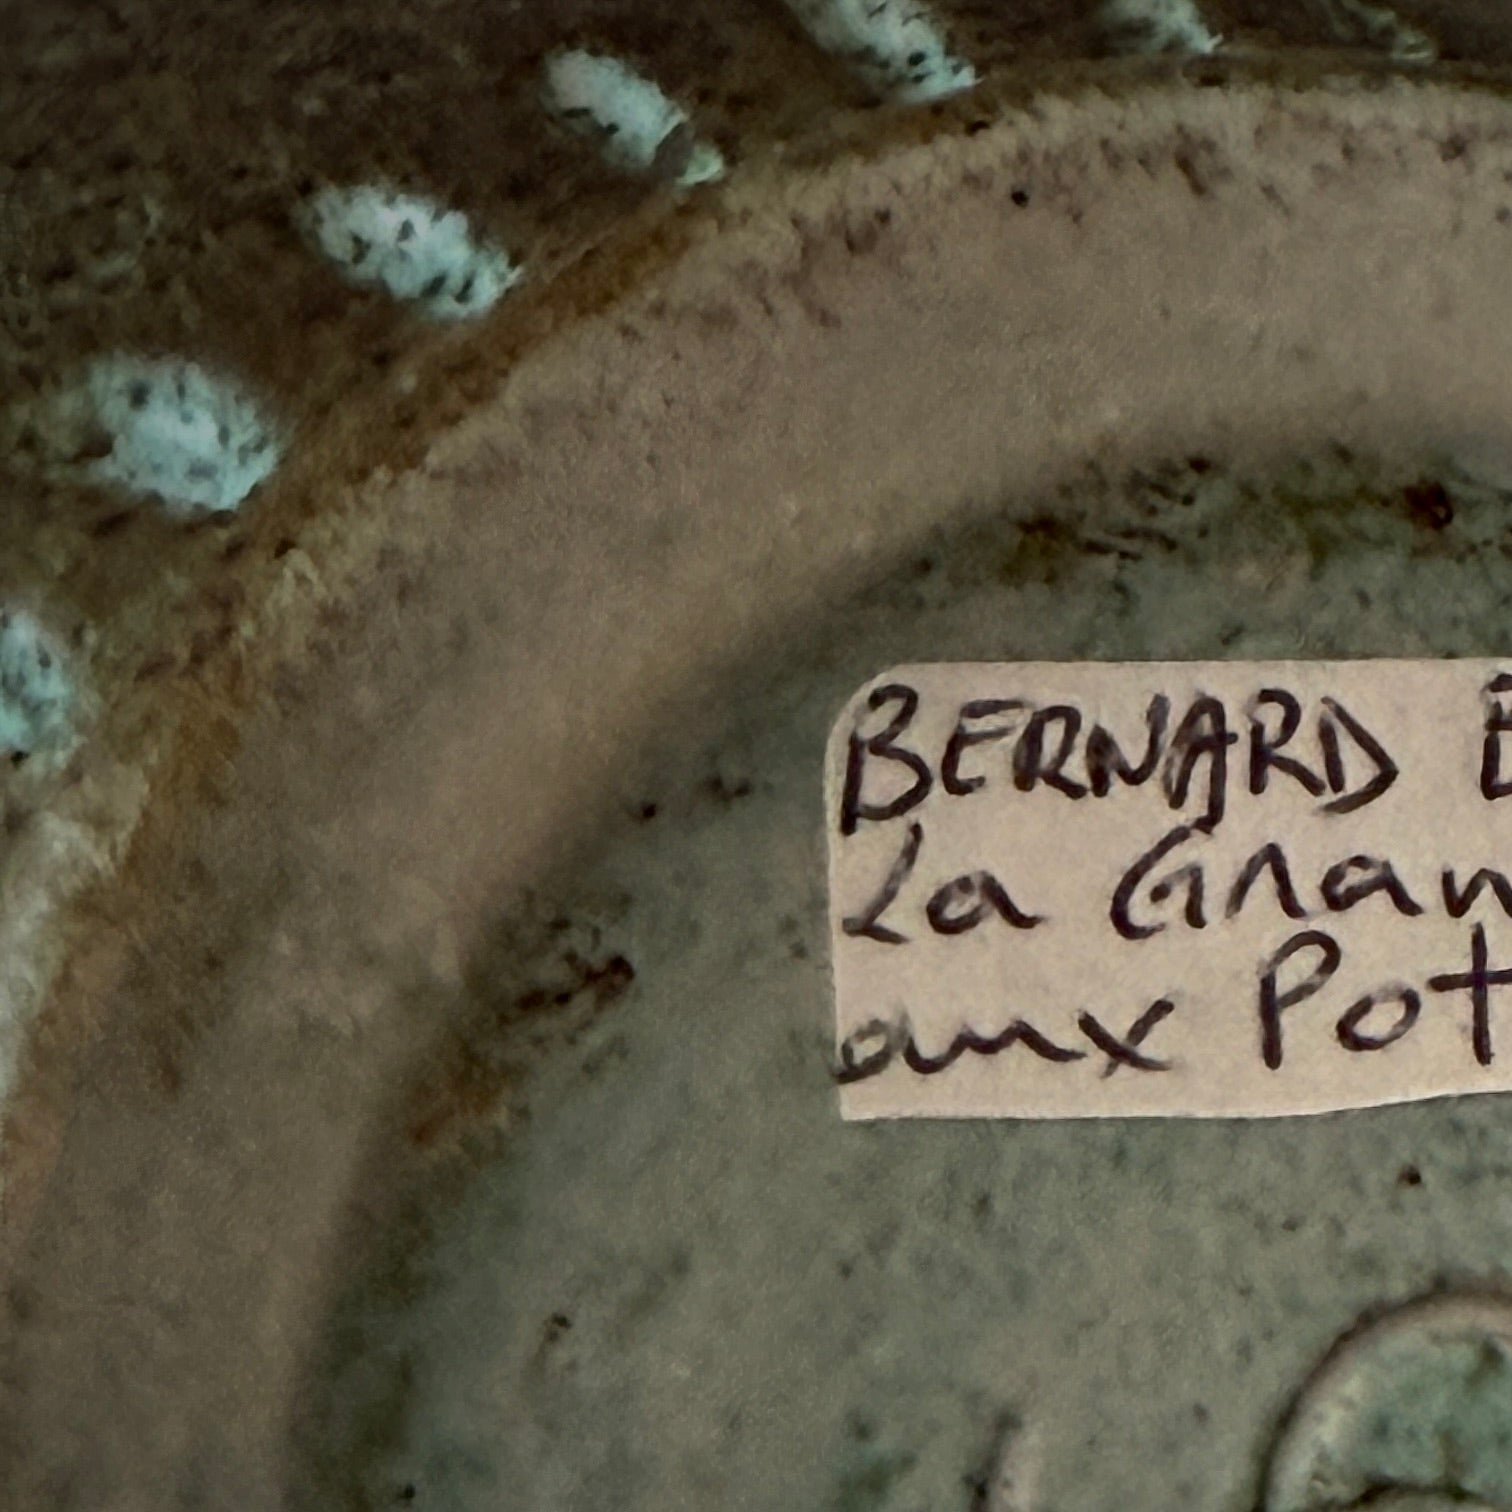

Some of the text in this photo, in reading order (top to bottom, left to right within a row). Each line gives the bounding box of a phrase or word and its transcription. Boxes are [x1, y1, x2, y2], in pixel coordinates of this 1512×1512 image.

[840, 684, 1399, 834] BERNARD
[842, 823, 1042, 944] La
[837, 998, 1176, 1083] aux
